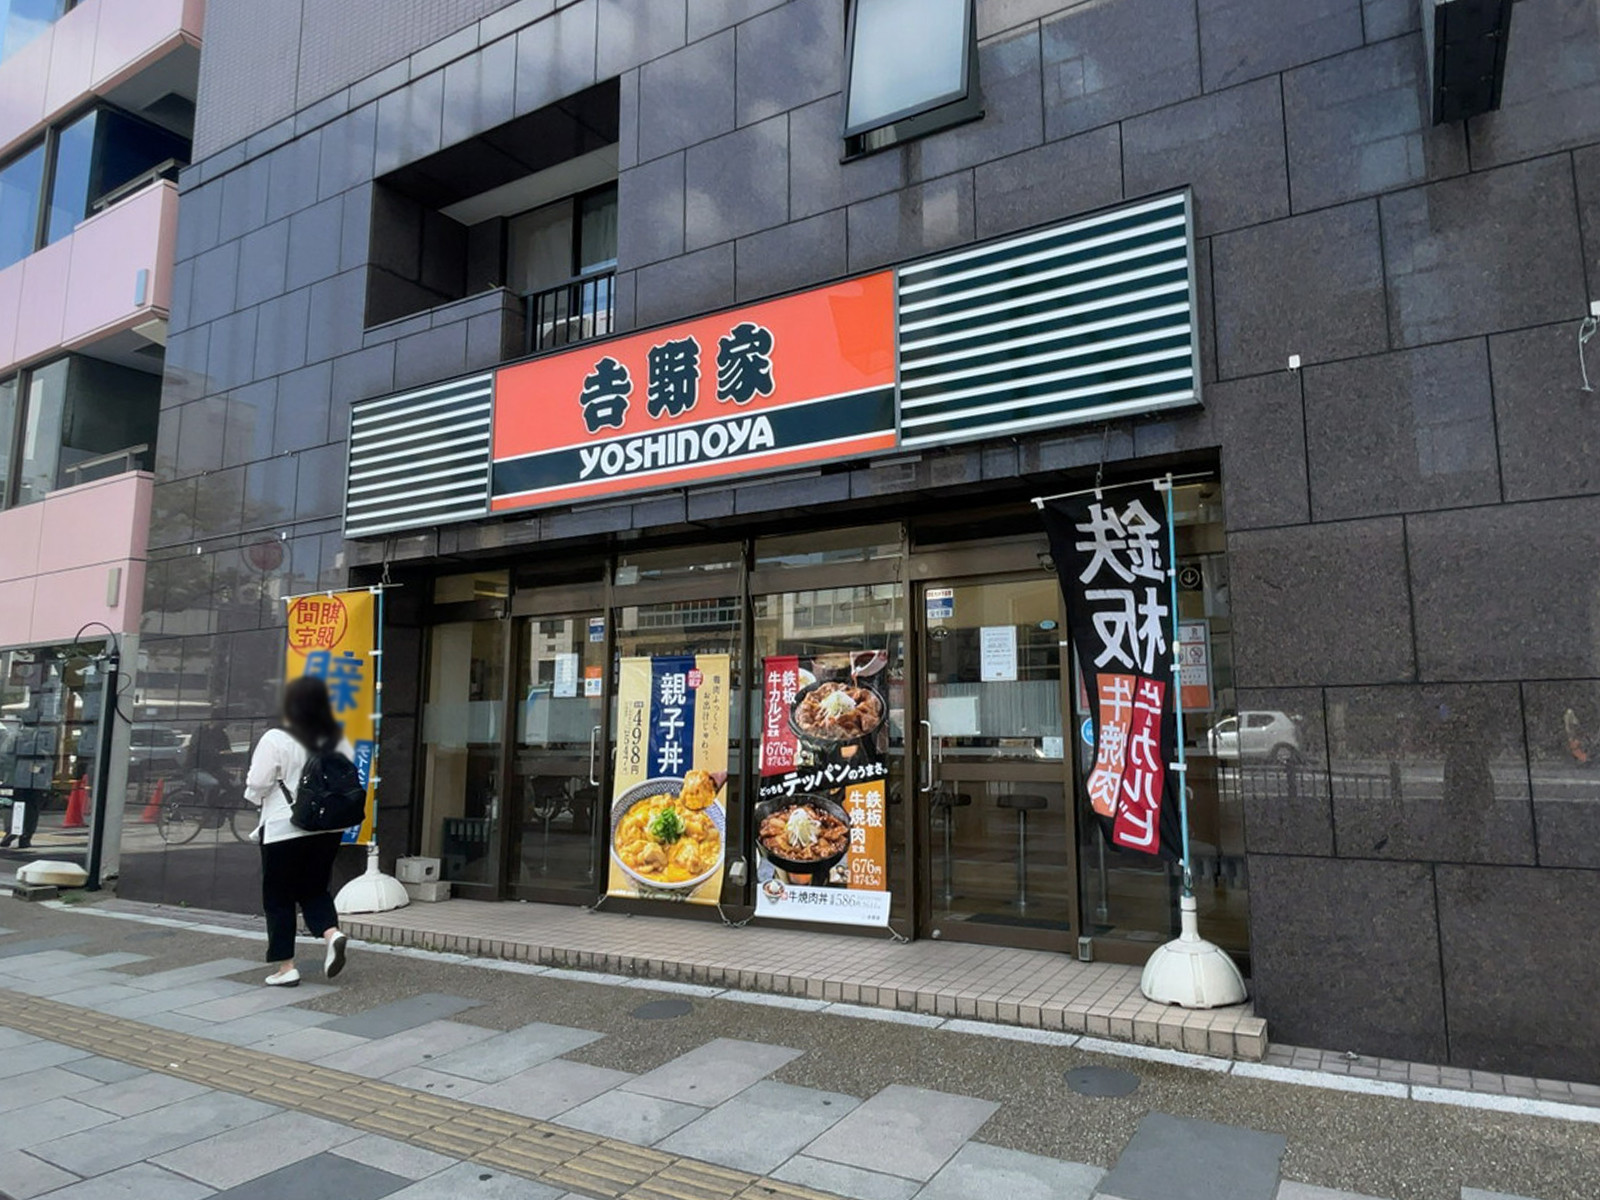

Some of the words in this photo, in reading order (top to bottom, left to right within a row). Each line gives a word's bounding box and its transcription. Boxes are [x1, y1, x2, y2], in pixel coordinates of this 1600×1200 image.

[579, 415, 776, 480] YOSHINOYA
[782, 670, 797, 704] 鉄板
[657, 672, 687, 774] 親子丼
[865, 790, 883, 827] 鉄板
